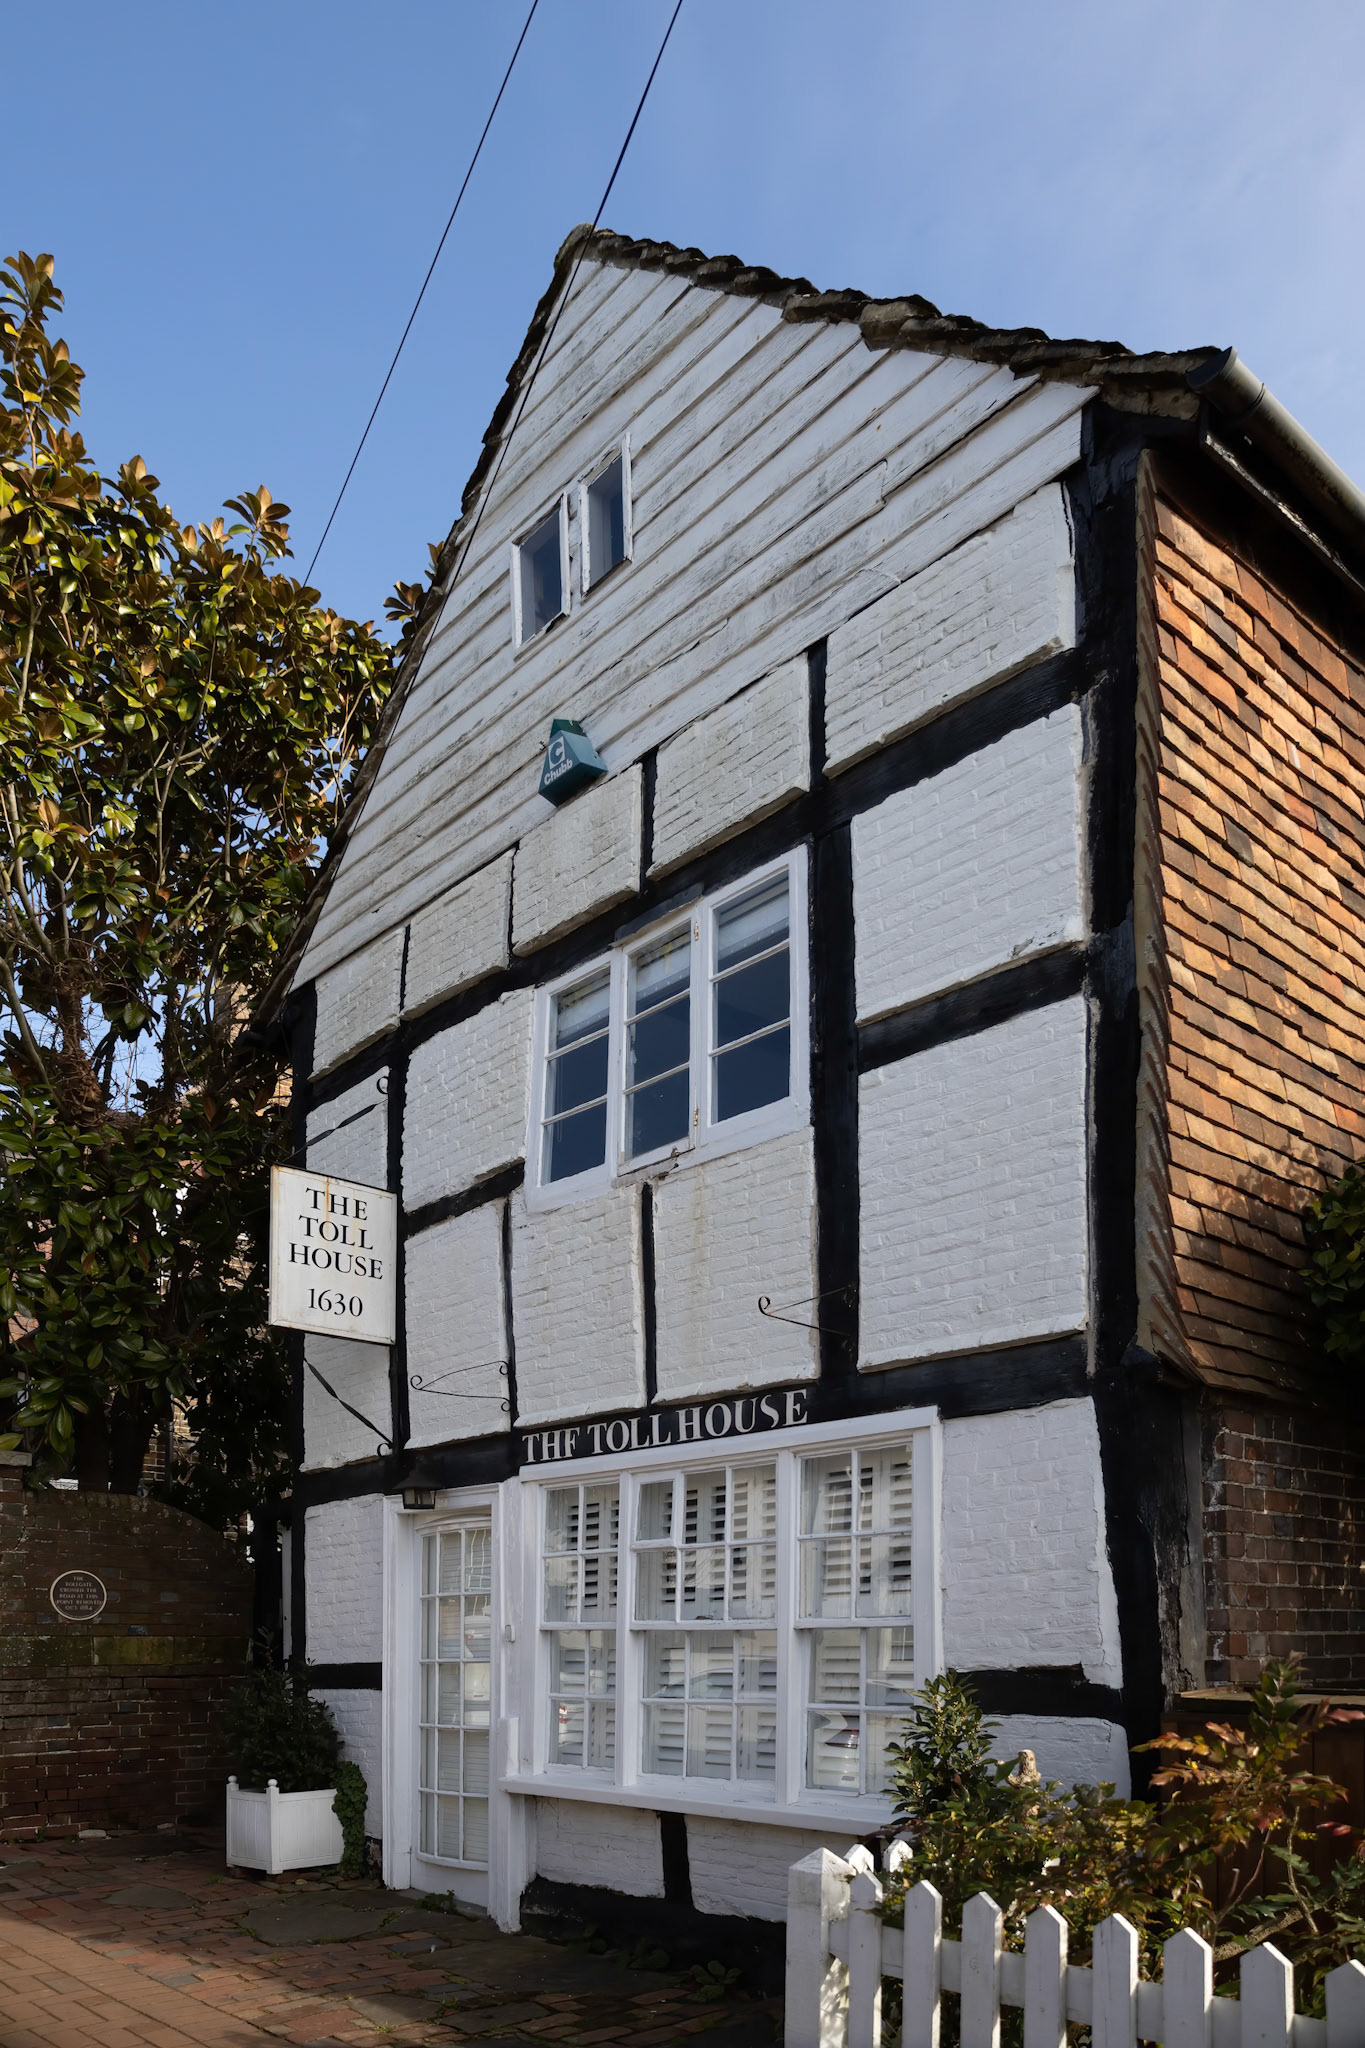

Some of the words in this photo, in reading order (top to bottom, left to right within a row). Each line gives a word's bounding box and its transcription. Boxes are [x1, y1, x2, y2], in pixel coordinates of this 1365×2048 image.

[544, 758, 573, 786] Chubb
[305, 1187, 368, 1221] THE
[298, 1214, 374, 1250] TOLL
[288, 1241, 383, 1280] HOUSE
[307, 1288, 363, 1318] 1630
[587, 1413, 671, 1455] TOLL
[675, 1388, 808, 1443] HOUSE
